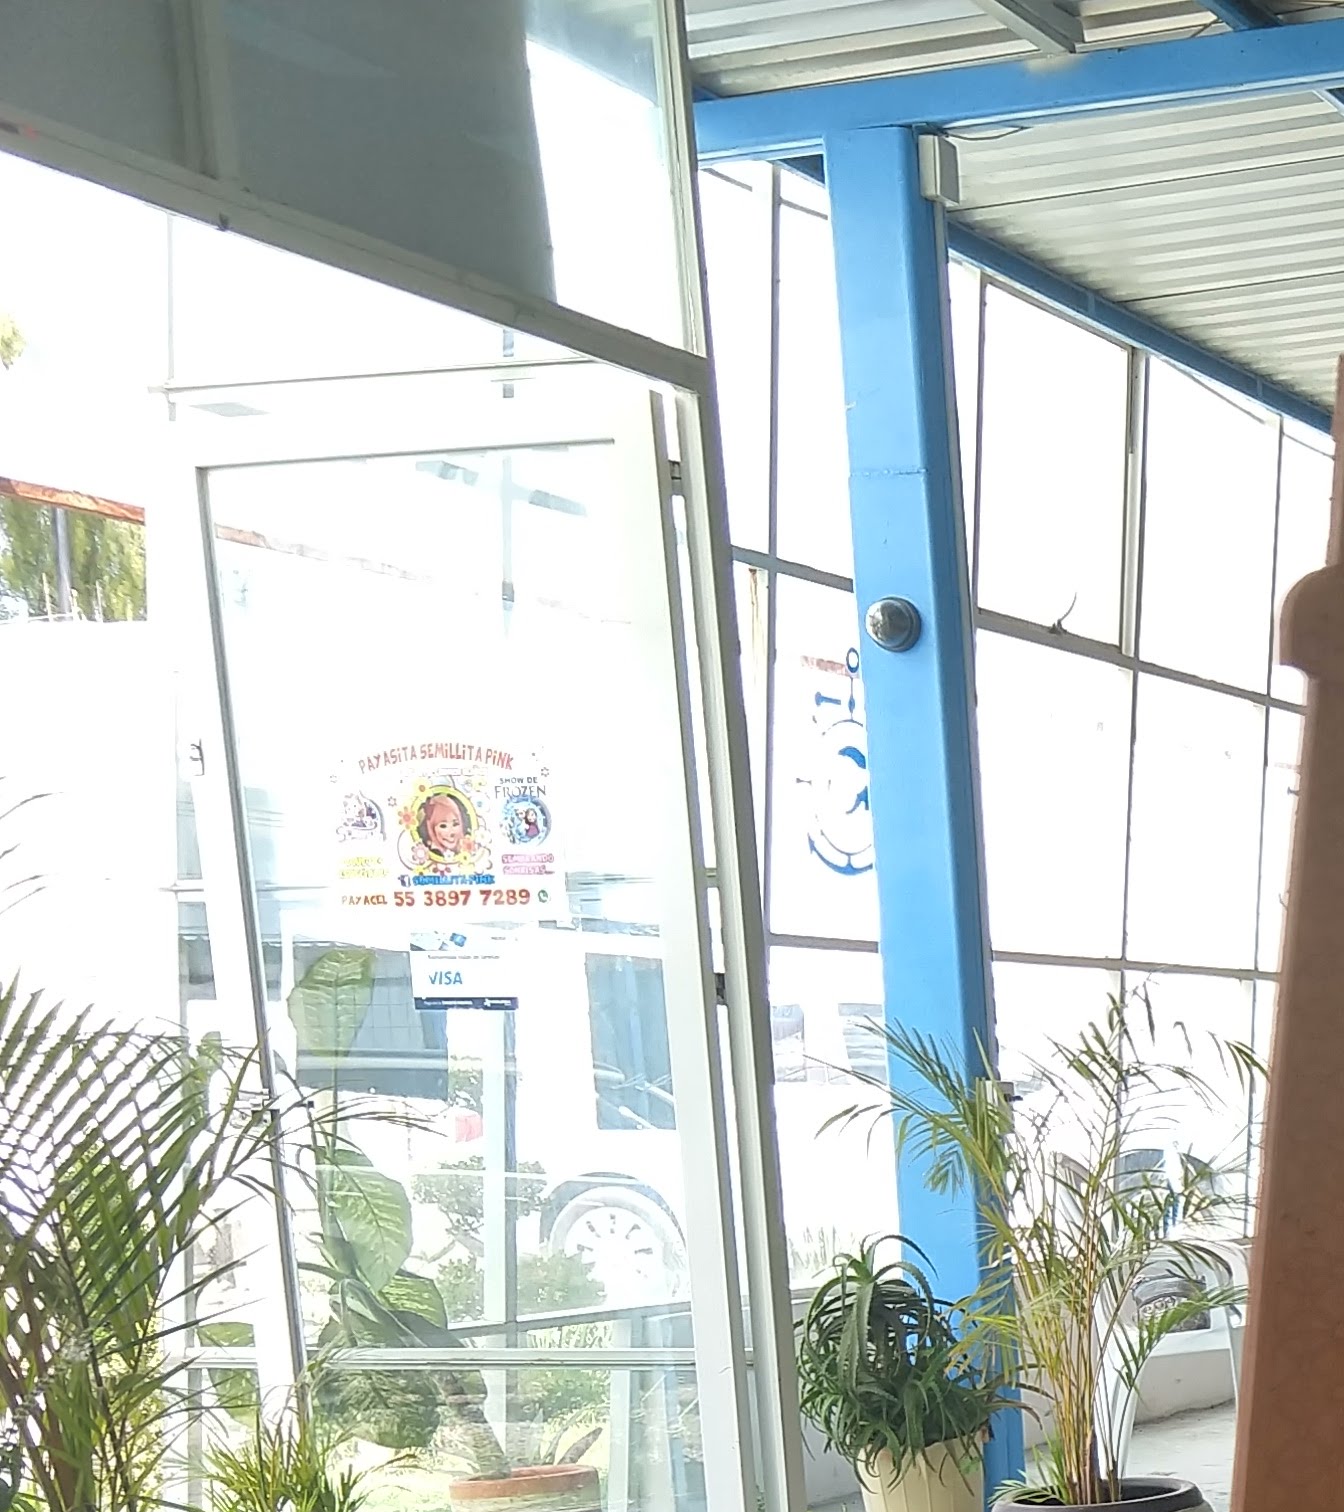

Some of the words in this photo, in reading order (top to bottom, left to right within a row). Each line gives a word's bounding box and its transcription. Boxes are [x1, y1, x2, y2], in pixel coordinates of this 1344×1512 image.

[499, 777, 524, 785] SHOW
[526, 776, 538, 784] DE
[494, 785, 547, 800] FROZEN
[394, 891, 415, 907] 55
[423, 889, 472, 907] 3897
[479, 889, 532, 906] 7289
[428, 970, 463, 986] VISA
